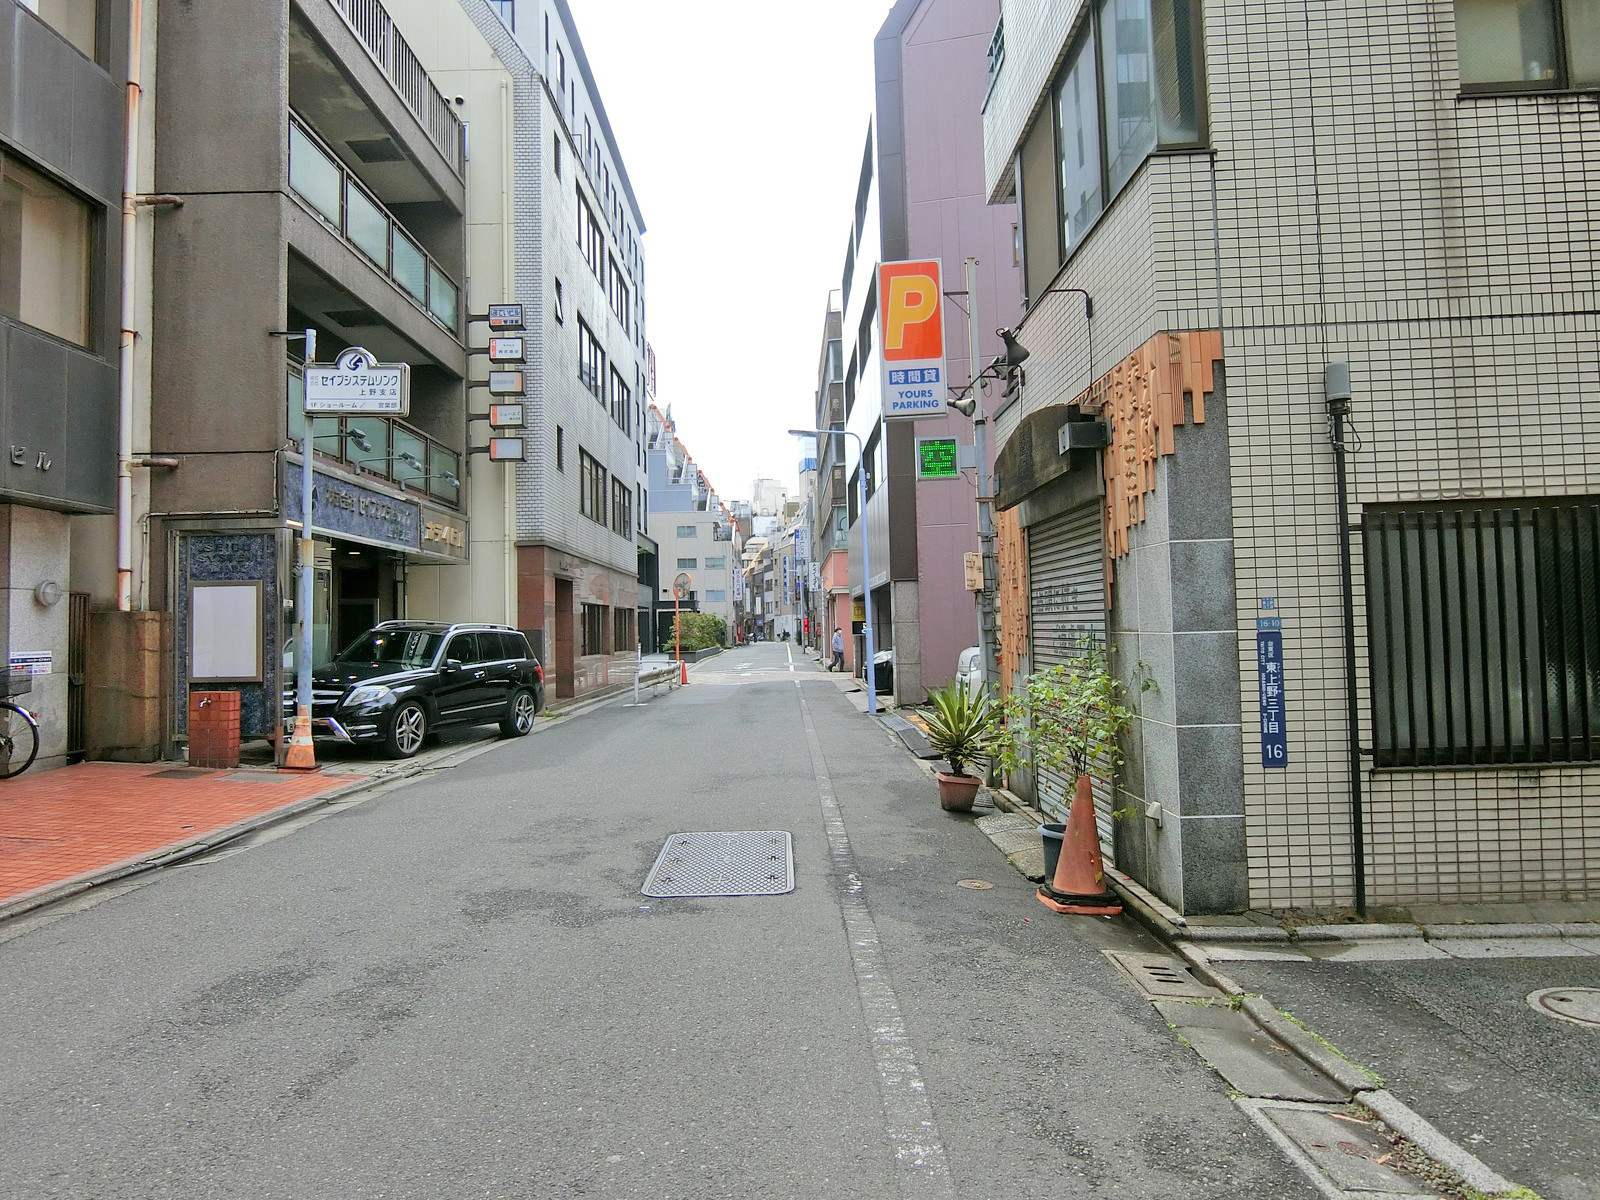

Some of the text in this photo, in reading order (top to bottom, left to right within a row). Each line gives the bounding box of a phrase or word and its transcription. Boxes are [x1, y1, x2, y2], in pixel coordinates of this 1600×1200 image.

[884, 274, 938, 350] P
[321, 375, 398, 387] セイブシステムリンク
[891, 369, 939, 383] 時間貸
[359, 388, 397, 396] 上野支店
[898, 389, 933, 399] YOURS
[892, 399, 940, 410] PARKING
[1259, 619, 1280, 628] 16-10
[1266, 661, 1280, 734] 東上野三丁目
[1266, 744, 1283, 759] 16
